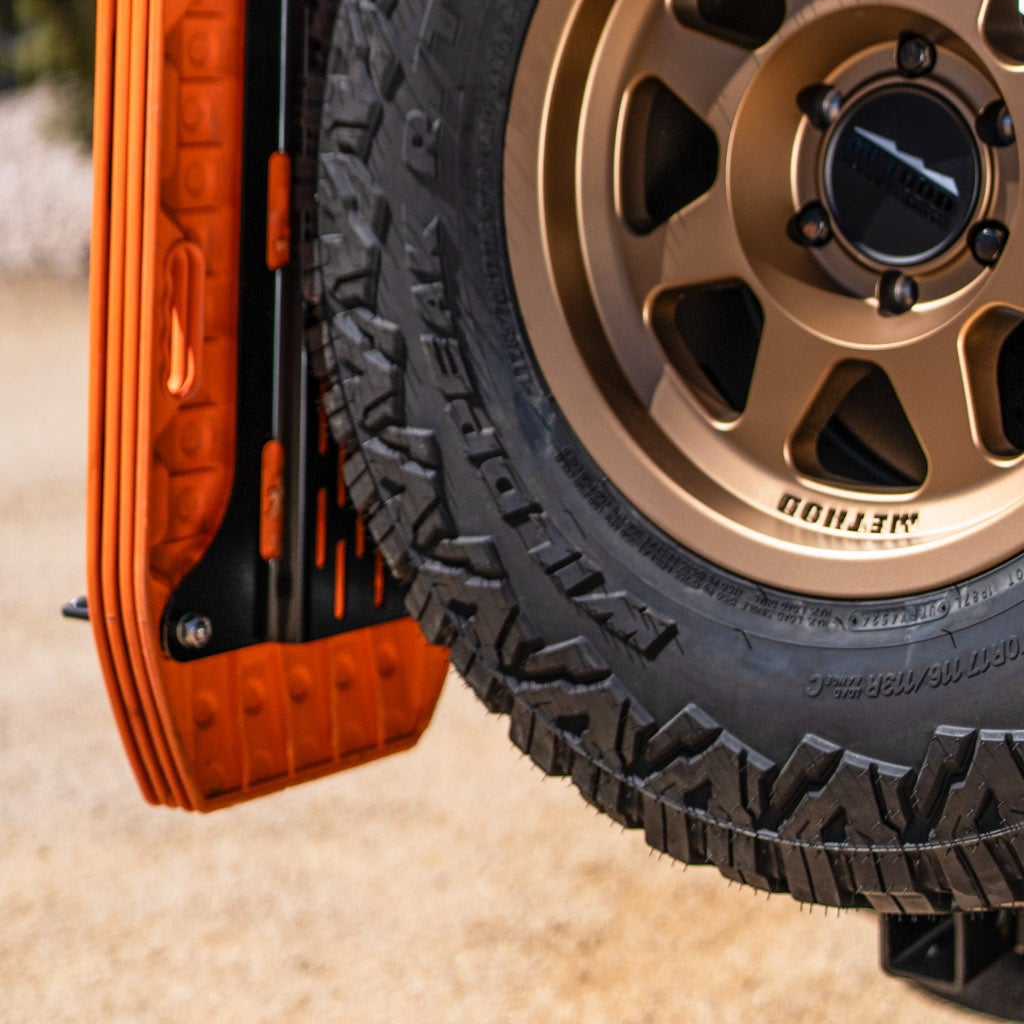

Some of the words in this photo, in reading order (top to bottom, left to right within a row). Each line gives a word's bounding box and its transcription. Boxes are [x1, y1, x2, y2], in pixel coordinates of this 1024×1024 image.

[403, 215, 677, 663] WILDPEAK
[776, 492, 920, 534] METHOD
[804, 672, 823, 699] C
[865, 658, 964, 699] 116/113R
